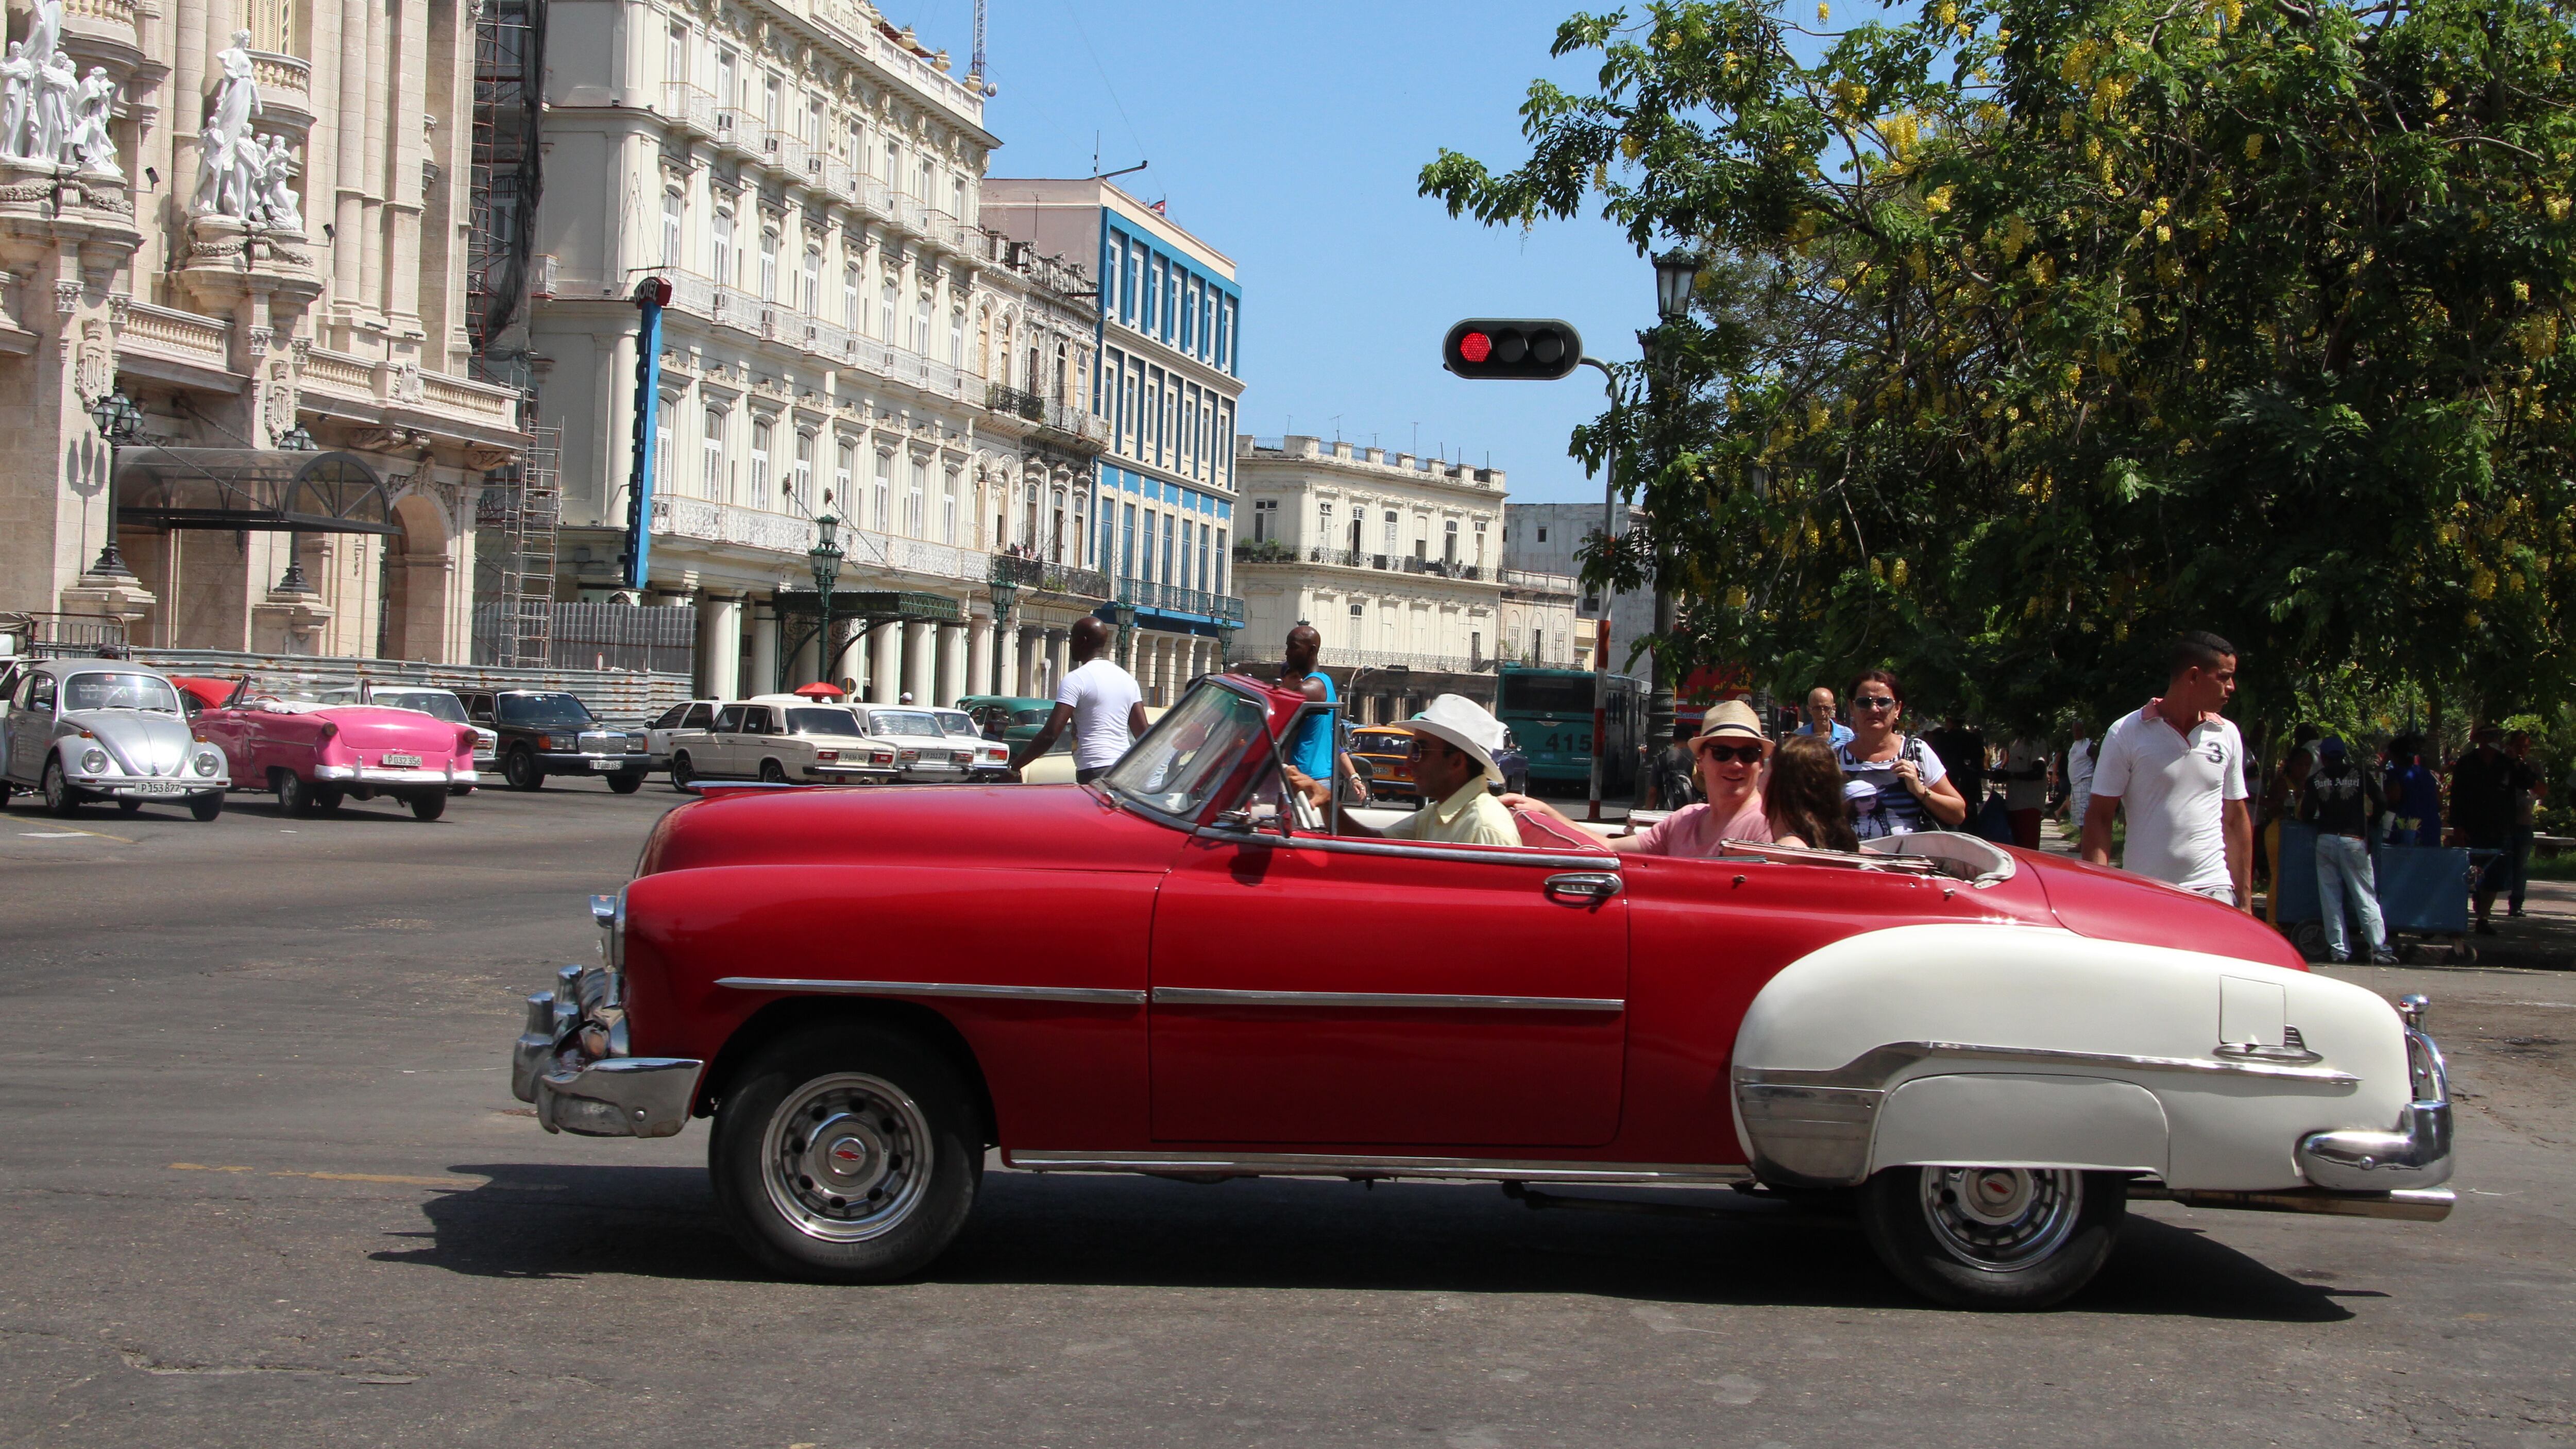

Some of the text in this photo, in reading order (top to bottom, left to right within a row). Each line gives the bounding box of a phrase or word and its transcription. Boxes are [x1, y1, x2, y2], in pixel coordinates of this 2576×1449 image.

[823, 0, 863, 38] INGLATERRA
[634, 280, 658, 305] HOTEL
[2206, 742, 2223, 764] 3
[2334, 777, 2359, 788] Angel
